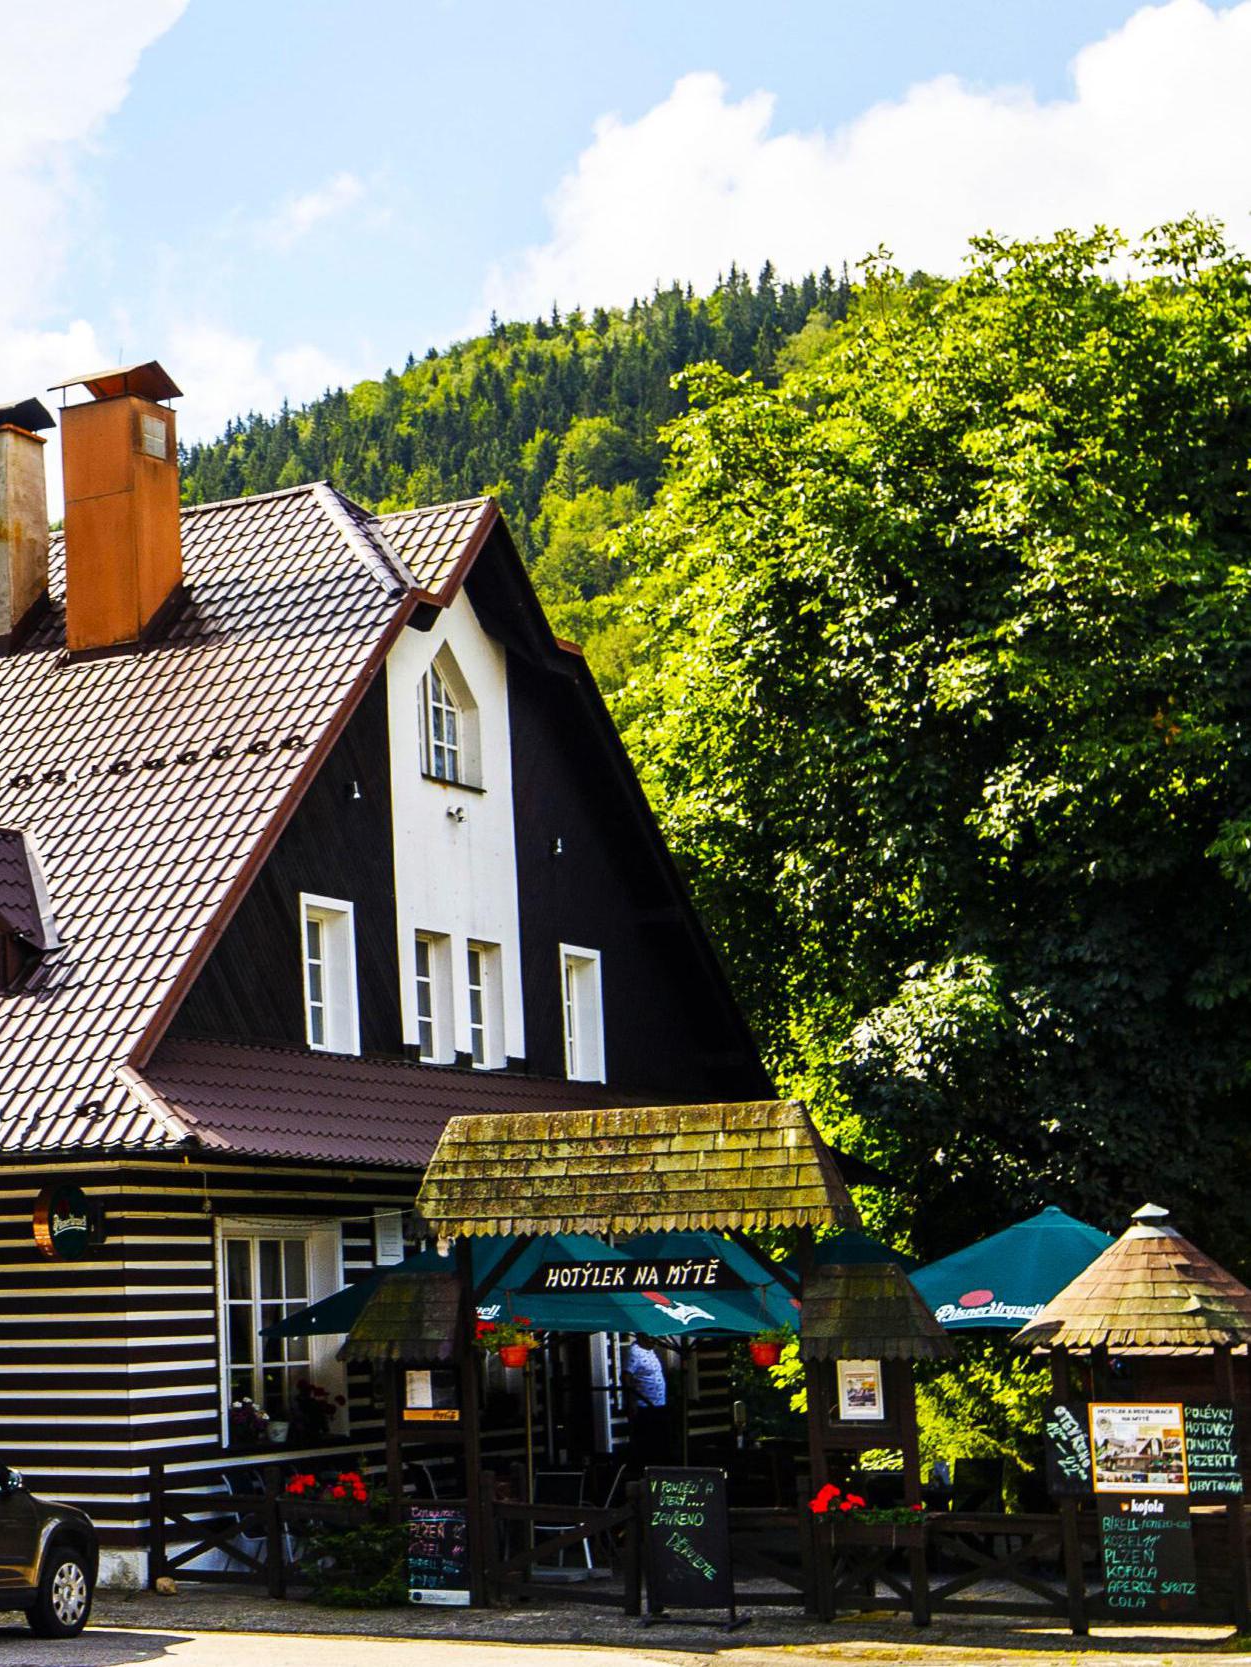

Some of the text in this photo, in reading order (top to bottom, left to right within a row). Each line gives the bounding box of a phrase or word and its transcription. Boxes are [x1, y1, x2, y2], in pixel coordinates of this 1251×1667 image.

[545, 1259, 720, 1288] HOTÝLEK NA MÝTĚ
[934, 1304, 990, 1322] Pilsner
[1184, 1403, 1233, 1420] POLÉVKY
[1185, 1421, 1234, 1437] HOTOVKY
[1187, 1454, 1238, 1468] DEZERTY
[1131, 1499, 1164, 1516] kofola
[1106, 1566, 1158, 1579] KOFOLA
[1107, 1580, 1156, 1593] APEROL
[1108, 1596, 1147, 1608] COLA
